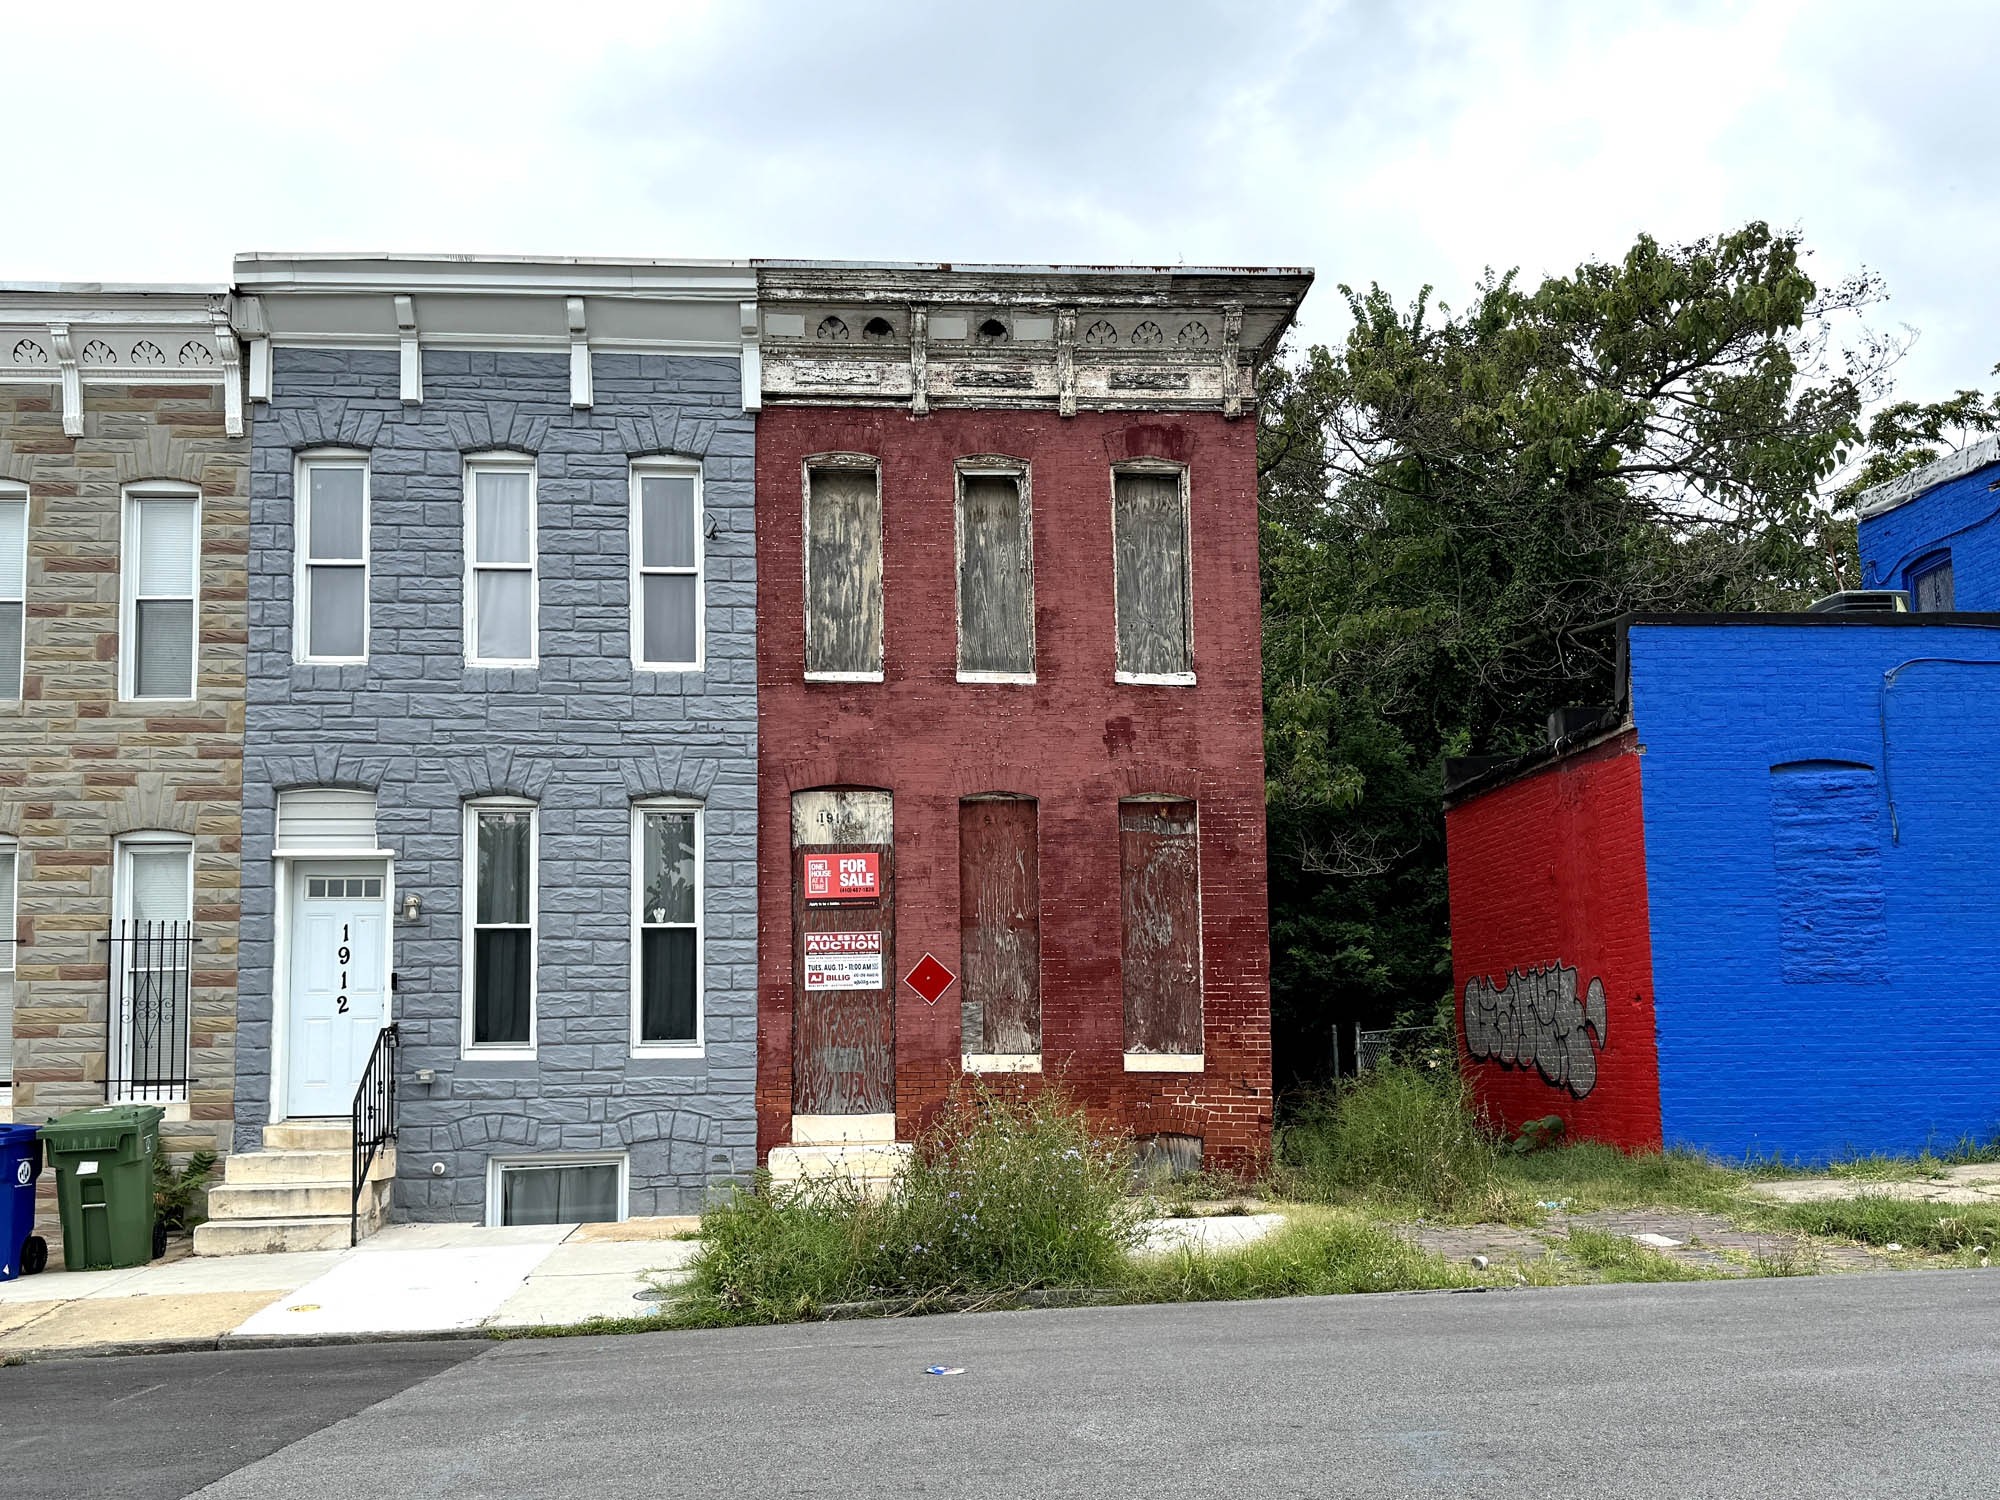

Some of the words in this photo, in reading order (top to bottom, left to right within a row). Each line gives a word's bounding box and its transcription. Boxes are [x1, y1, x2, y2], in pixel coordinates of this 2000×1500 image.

[840, 859, 866, 873] FOR
[840, 873, 874, 886] SALE
[808, 941, 879, 950] AUCTION
[337, 924, 350, 1014] 1912
